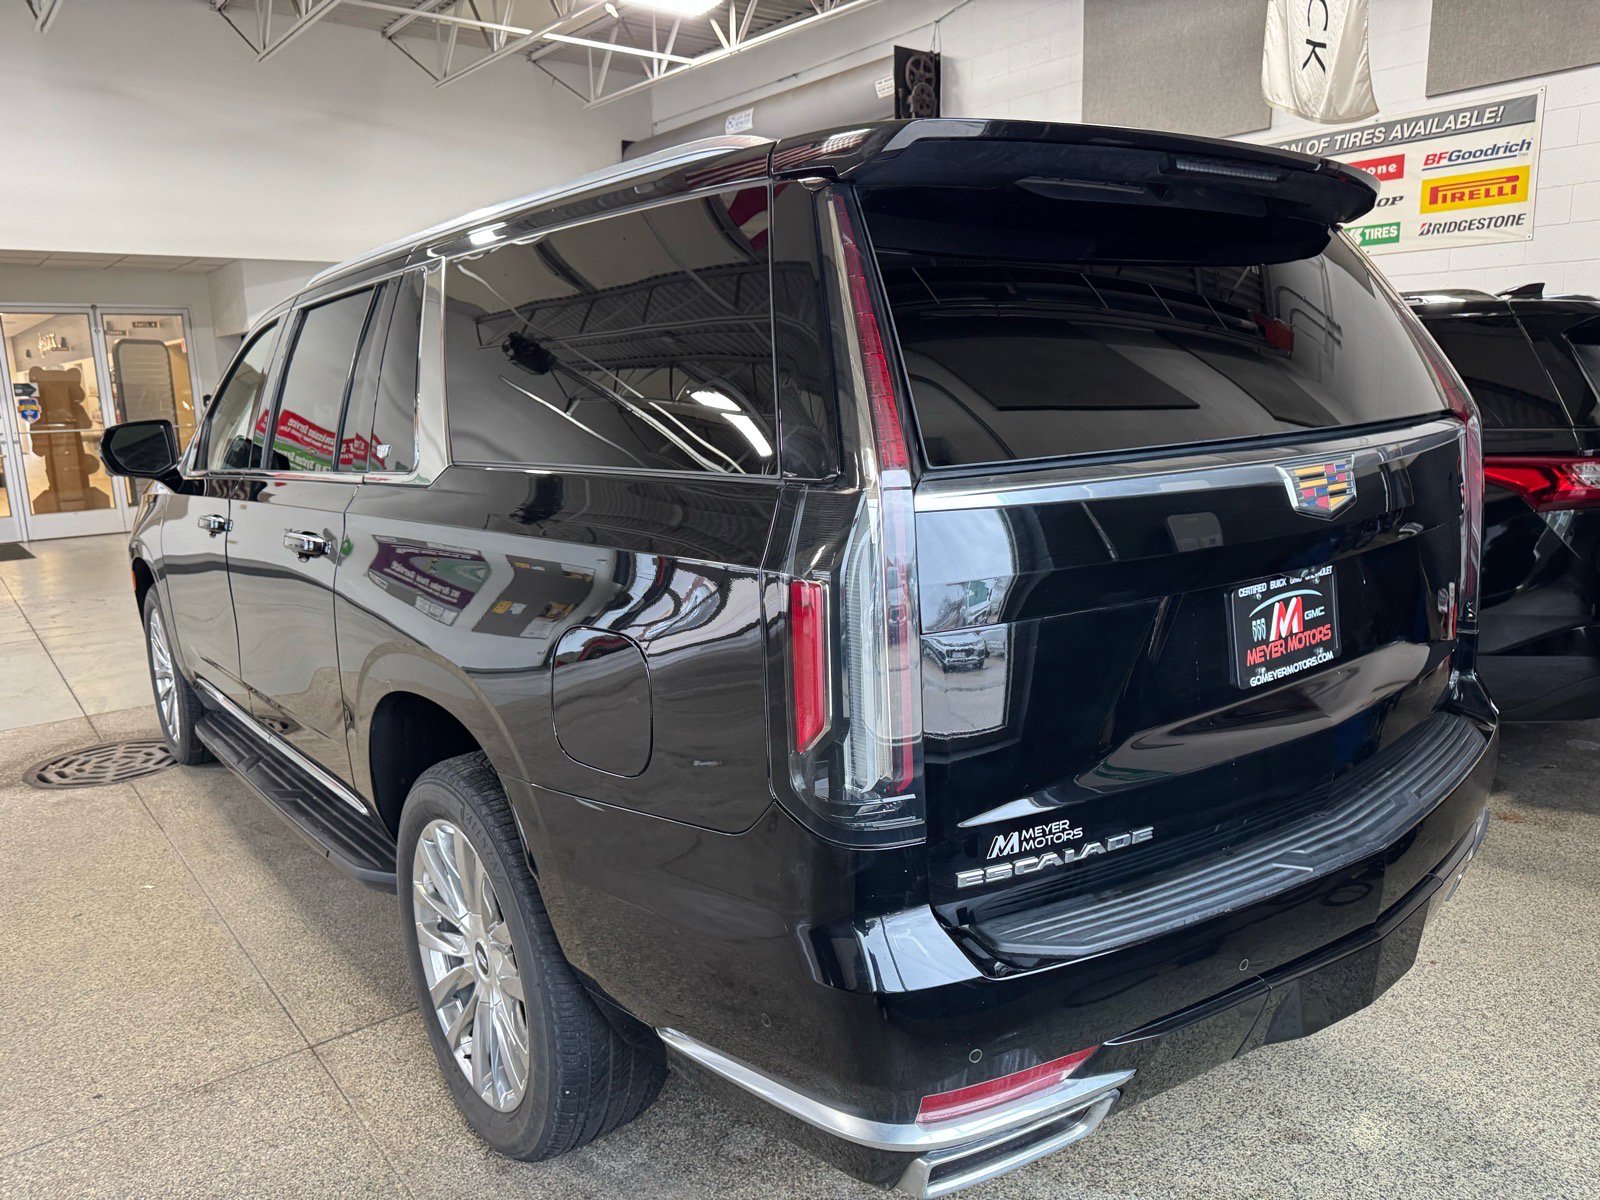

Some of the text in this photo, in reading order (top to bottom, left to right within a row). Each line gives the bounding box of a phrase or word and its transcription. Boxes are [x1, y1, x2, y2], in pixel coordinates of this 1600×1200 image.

[1306, 136, 1332, 155] OF
[1334, 127, 1386, 151] TIRES
[1388, 105, 1505, 141] AVAILABLE!
[1423, 138, 1532, 166] BFGoodrich
[1429, 175, 1520, 205] PIRELLI
[1364, 225, 1398, 240] TIRES
[1418, 213, 1527, 236] BRIDGESTONE
[1238, 582, 1267, 598] CERTIFIED
[1270, 578, 1287, 590] BUICK
[1304, 606, 1326, 620] GMC
[1246, 623, 1332, 667] MEYER MOTORS
[1250, 650, 1334, 687] GOMEYERMOTORS.COM
[1021, 819, 1070, 840] MEYER
[1021, 827, 1083, 852] MOTORS
[955, 826, 1154, 888] ESCALADE
